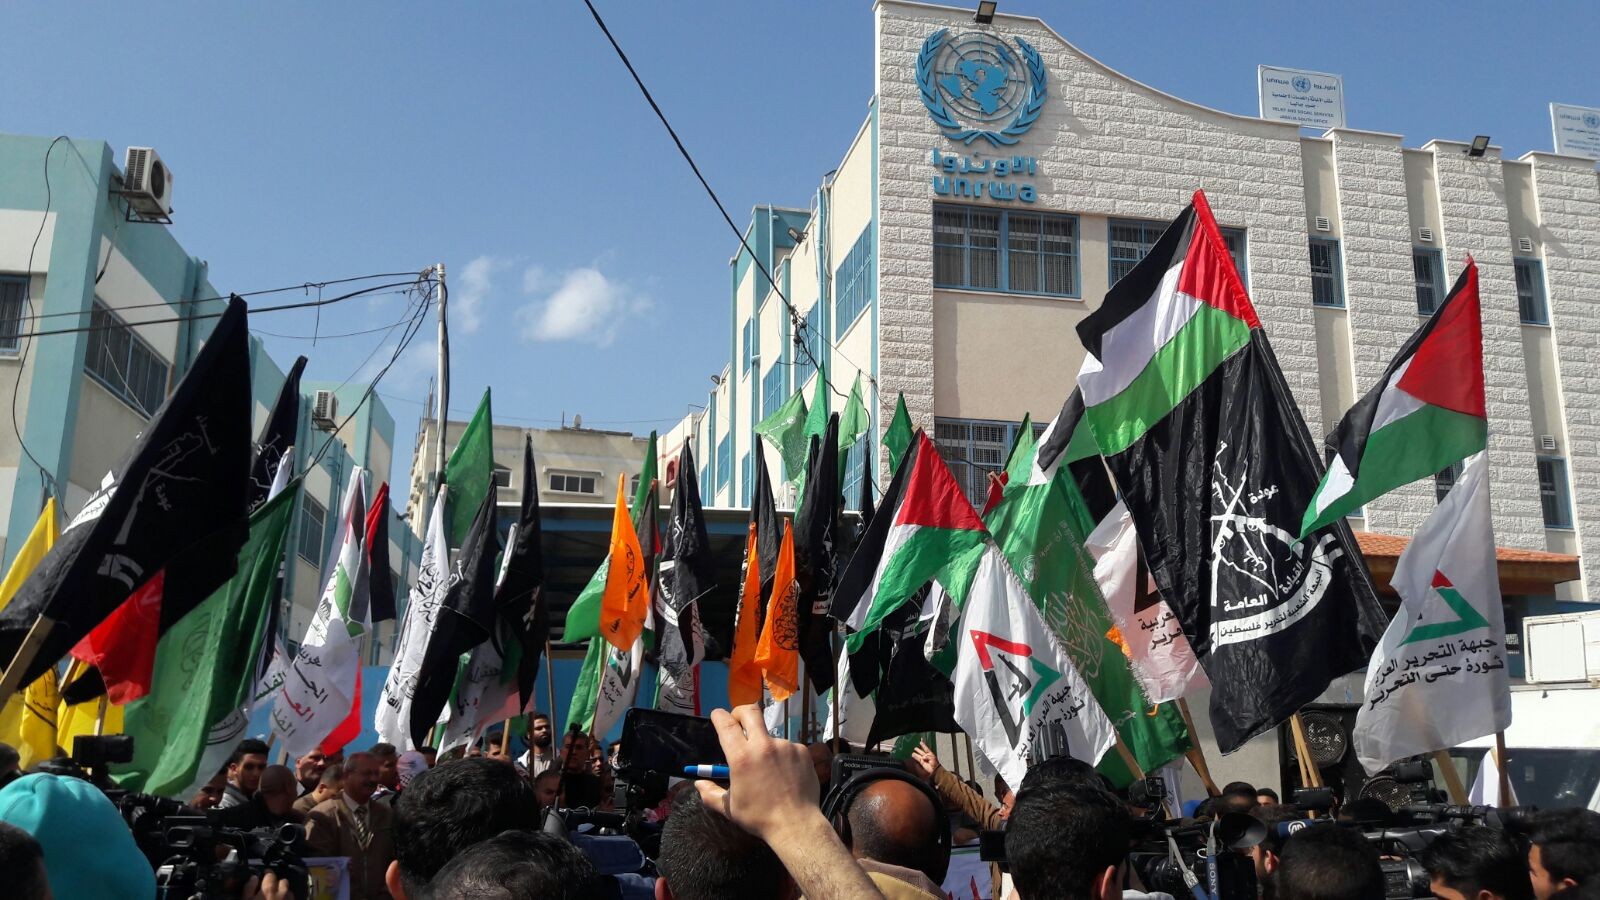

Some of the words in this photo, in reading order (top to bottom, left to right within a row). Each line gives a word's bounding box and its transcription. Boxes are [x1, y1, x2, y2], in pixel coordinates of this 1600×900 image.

[1223, 593, 1268, 612] العامة
[1220, 620, 1261, 638] فلسطين
[1460, 637, 1498, 654] جبهة
[1402, 642, 1457, 671] التحرير
[1425, 666, 1461, 683] حتى
[1369, 671, 1420, 711] التحرير
[1209, 862, 1217, 896] SONY
